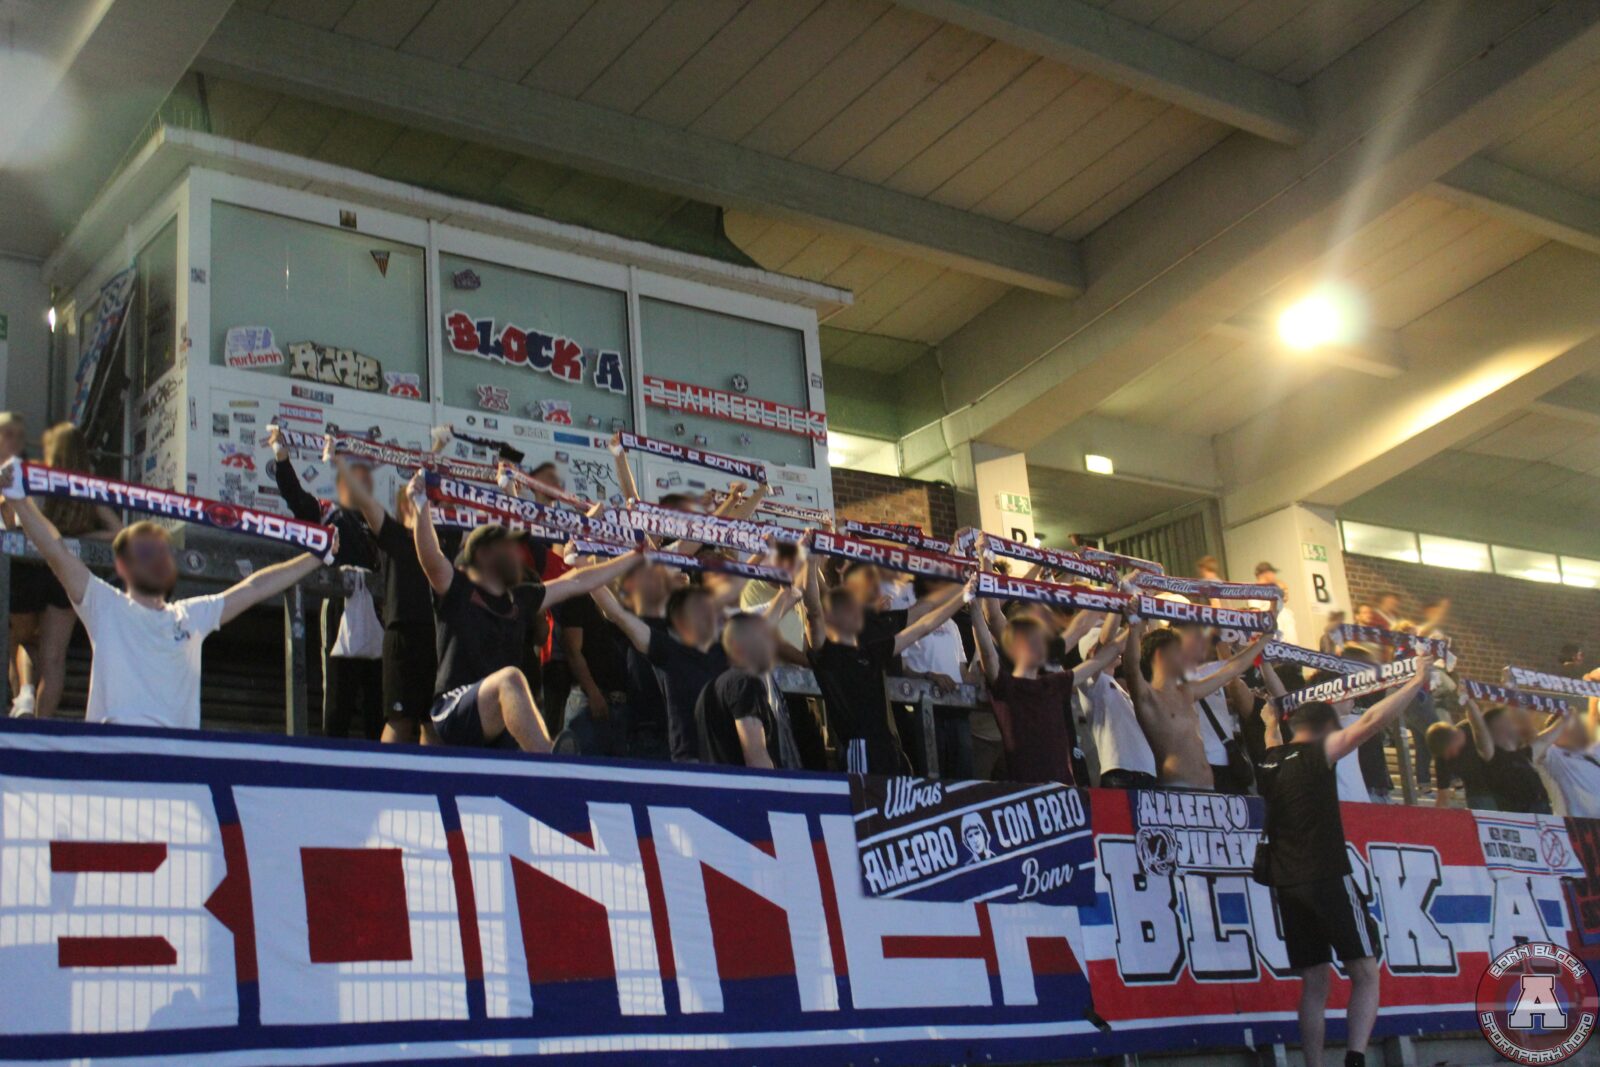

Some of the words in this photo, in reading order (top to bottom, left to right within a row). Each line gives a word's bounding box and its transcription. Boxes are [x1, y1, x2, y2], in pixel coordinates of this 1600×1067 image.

[446, 311, 583, 383] BLOCK
[594, 351, 627, 395] A
[28, 468, 203, 521] SPORTPARK
[242, 511, 328, 552] NORD
[440, 478, 539, 520] ALLEGRO
[815, 534, 884, 564] BLOCK
[1312, 573, 1328, 603] B
[1142, 597, 1198, 621] BLOCK
[1217, 611, 1259, 628] BONN
[884, 776, 943, 819] Ultras
[1139, 790, 1249, 835] ALLEGRO
[862, 825, 958, 893] ALLEGRO
[992, 801, 1035, 848] CON
[1034, 788, 1086, 836] BRIO
[1018, 857, 1074, 900] Bonn
